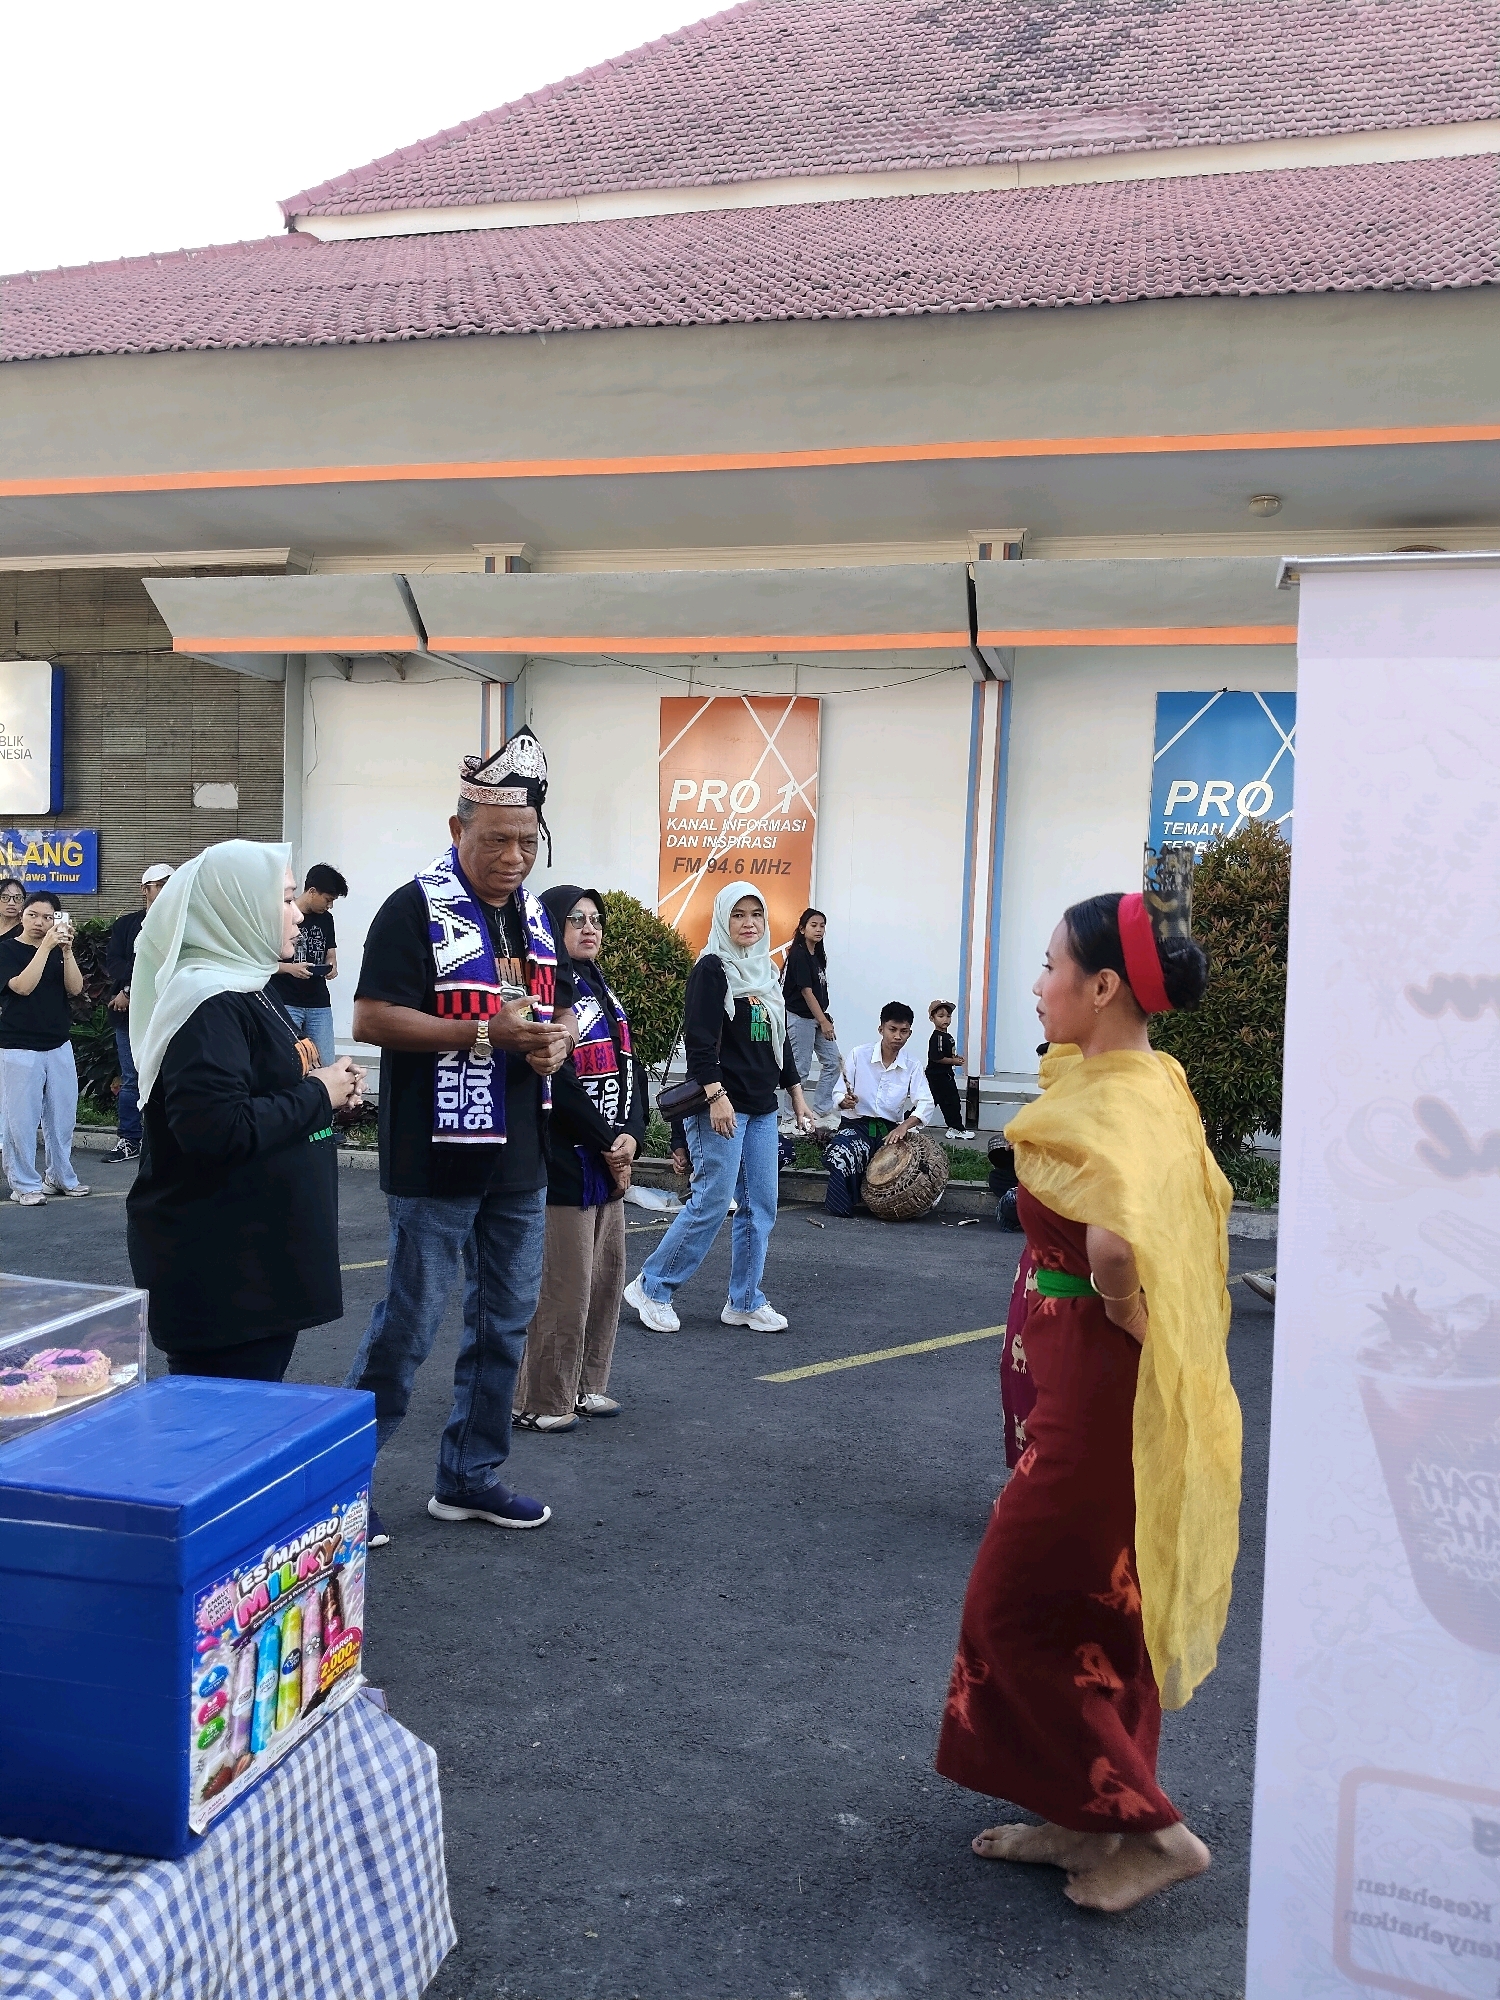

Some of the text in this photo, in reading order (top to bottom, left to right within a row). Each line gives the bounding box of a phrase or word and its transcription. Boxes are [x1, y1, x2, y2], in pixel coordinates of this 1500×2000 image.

[668, 780, 796, 814] PRO 1
[1163, 780, 1274, 818] PRO
[666, 818, 807, 832] KANAL INFORMASI
[1163, 821, 1225, 836] TEMAN
[0, 841, 84, 867] LANG
[666, 835, 777, 849] DAN INSPIRASI
[21, 872, 47, 882] Jawa
[49, 871, 81, 882] Timur
[672, 857, 792, 876] FM 94.6 MHz
[437, 1050, 459, 1129] NADE
[240, 1516, 340, 1593] ES MAMBO
[237, 1534, 342, 1628] MILKY
[329, 1633, 354, 1657] HARGA
